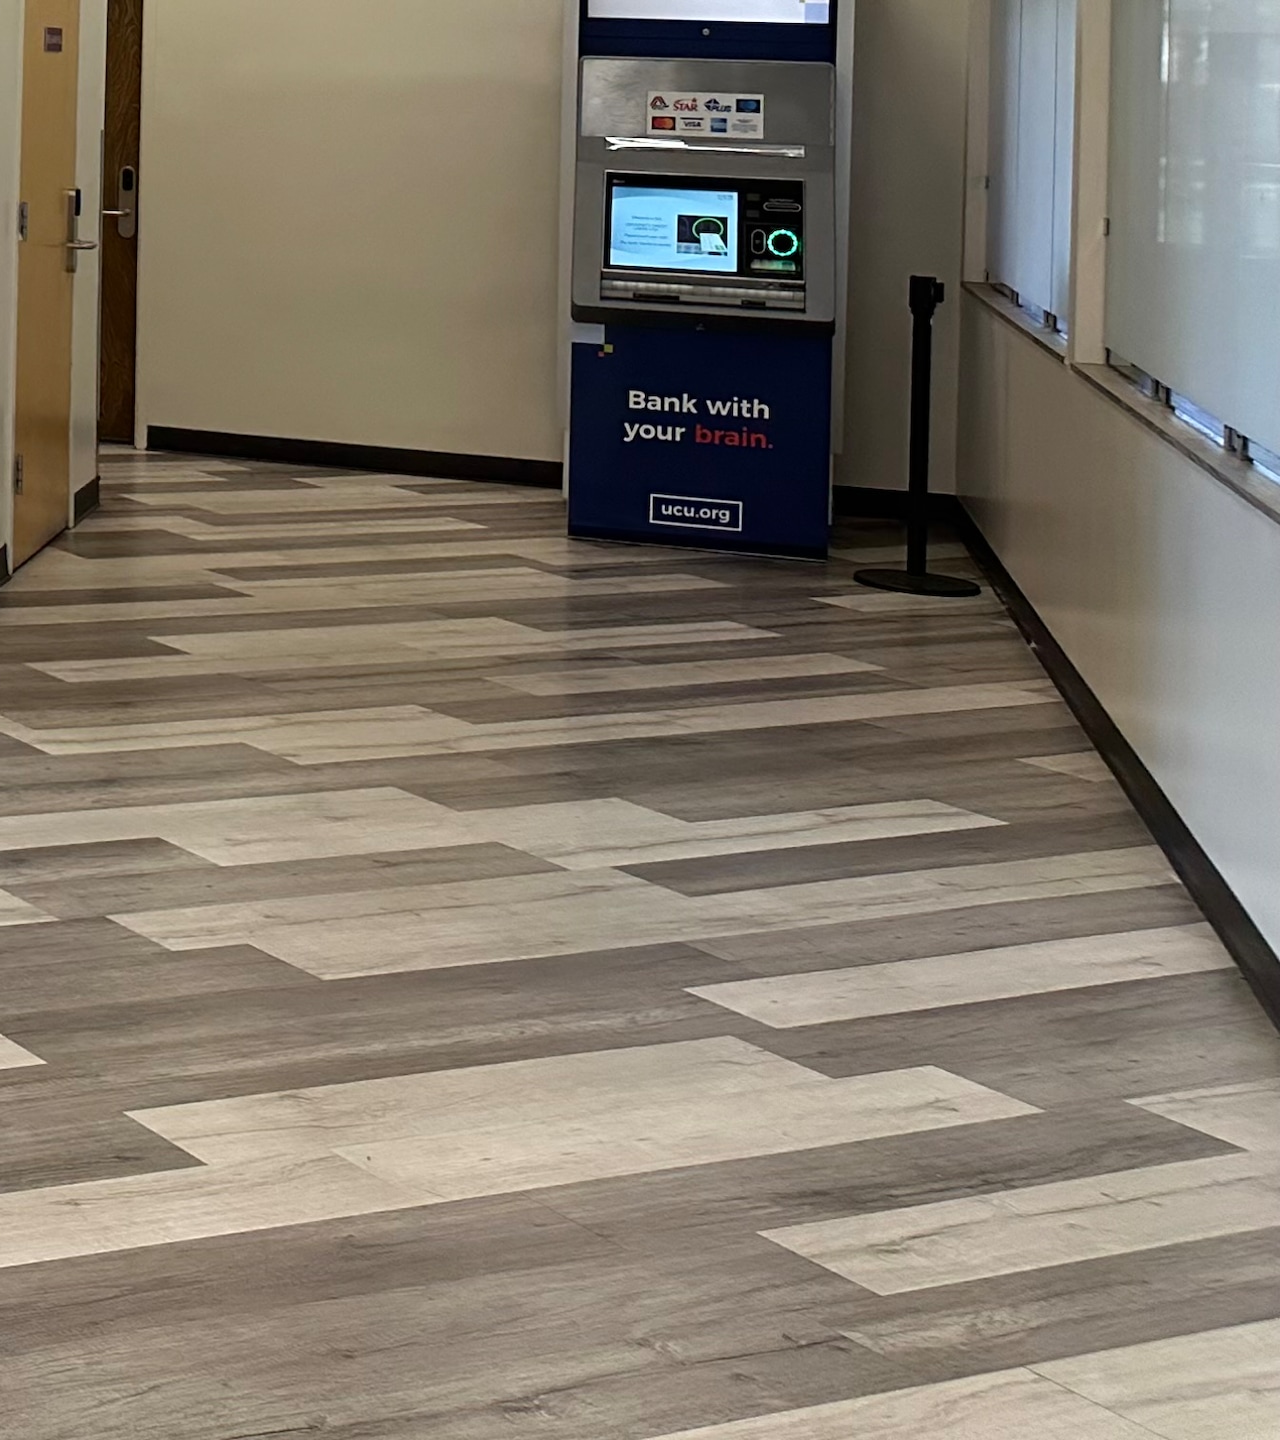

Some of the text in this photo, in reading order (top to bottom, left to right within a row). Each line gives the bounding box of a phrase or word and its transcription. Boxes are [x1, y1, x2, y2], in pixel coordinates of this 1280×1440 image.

[673, 98, 698, 112] STAR
[628, 390, 770, 419] Bank with
[623, 422, 773, 449] your brain.
[661, 503, 730, 523] ucu.org
